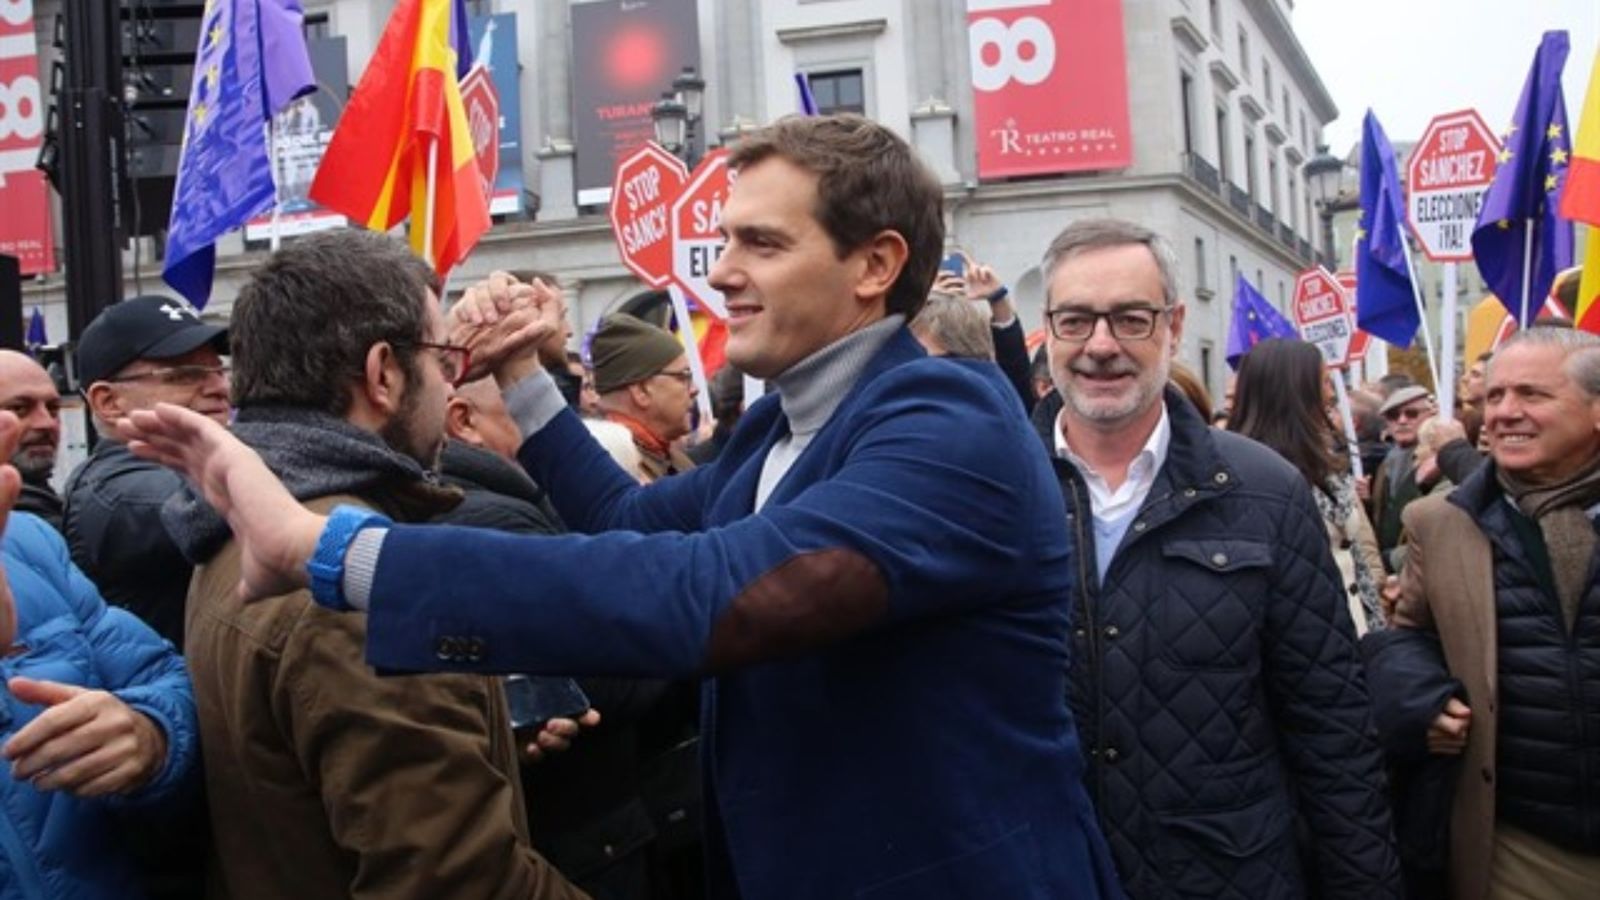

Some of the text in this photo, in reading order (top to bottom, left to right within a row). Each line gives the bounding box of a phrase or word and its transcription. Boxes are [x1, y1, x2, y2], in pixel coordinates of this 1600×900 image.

[596, 101, 656, 120] TURAN
[1025, 128, 1116, 144] TEATRO REAL
[1439, 127, 1469, 153] STOP
[1419, 150, 1486, 186] SÁNCHEZ
[624, 165, 660, 211] STOP
[1418, 192, 1481, 222] ELECCIONE
